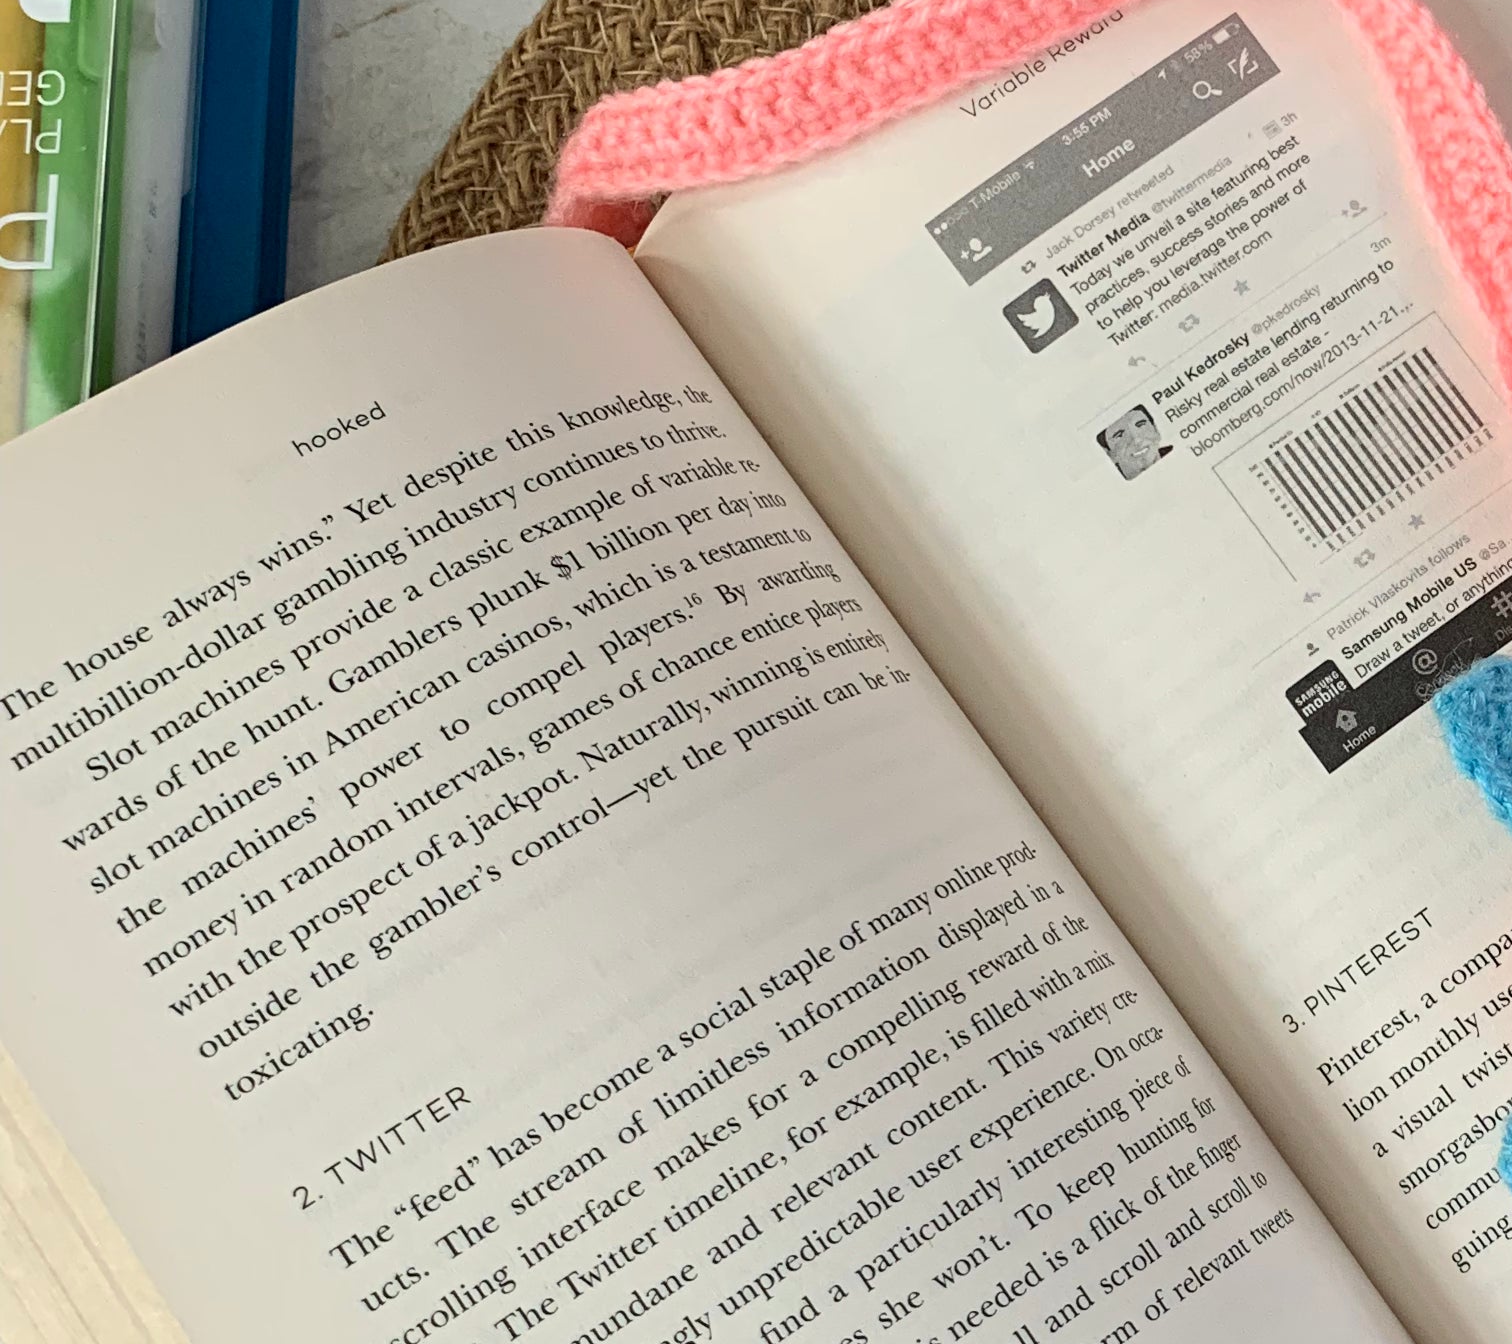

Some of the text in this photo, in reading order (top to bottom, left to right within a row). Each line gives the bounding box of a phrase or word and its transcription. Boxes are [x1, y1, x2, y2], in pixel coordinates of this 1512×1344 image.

[958, 49, 1048, 120] Variable
[1088, 105, 1113, 129] PM
[1081, 136, 1137, 179] Home
[1056, 212, 1151, 277] Twitter Media
[1069, 135, 1300, 295] Today we unveil a site featuring best
[1084, 154, 1311, 316] practices, success stories and more
[1096, 178, 1308, 331] to help you leverage the power of
[1106, 230, 1273, 346] Twitter: media.twitter.com
[1151, 332, 1250, 405] Paul Kedrosky
[291, 401, 388, 459] hooked
[62, 626, 153, 683] house
[162, 570, 251, 628] always
[343, 492, 397, 524] Yet
[404, 447, 498, 497] despite
[505, 422, 556, 451] this
[557, 390, 683, 431] knowledge,
[683, 385, 713, 404] the
[1341, 557, 1478, 660] Samsung Mobile US
[1295, 669, 1340, 708] SAMSUNG
[1301, 677, 1348, 719] mobile
[1282, 906, 1432, 1034] 3. PINTEREST
[328, 1224, 395, 1269] The
[486, 1128, 542, 1169] has
[539, 1057, 654, 1133] become
[656, 1044, 678, 1062] a
[679, 986, 758, 1049] social
[759, 946, 836, 999] staple
[839, 920, 868, 951] of
[867, 891, 932, 936] many
[934, 861, 997, 899] online
[1316, 1009, 1420, 1086] Pinterest,
[1420, 992, 1438, 1009] a
[1342, 1086, 1389, 1122] lion
[1388, 1012, 1480, 1089] monthly
[292, 1086, 472, 1210] 2. TWITTER
[1144, 1288, 1171, 1321] of
[1172, 1238, 1251, 1302] relevant
[1250, 1208, 1295, 1245] tweets
